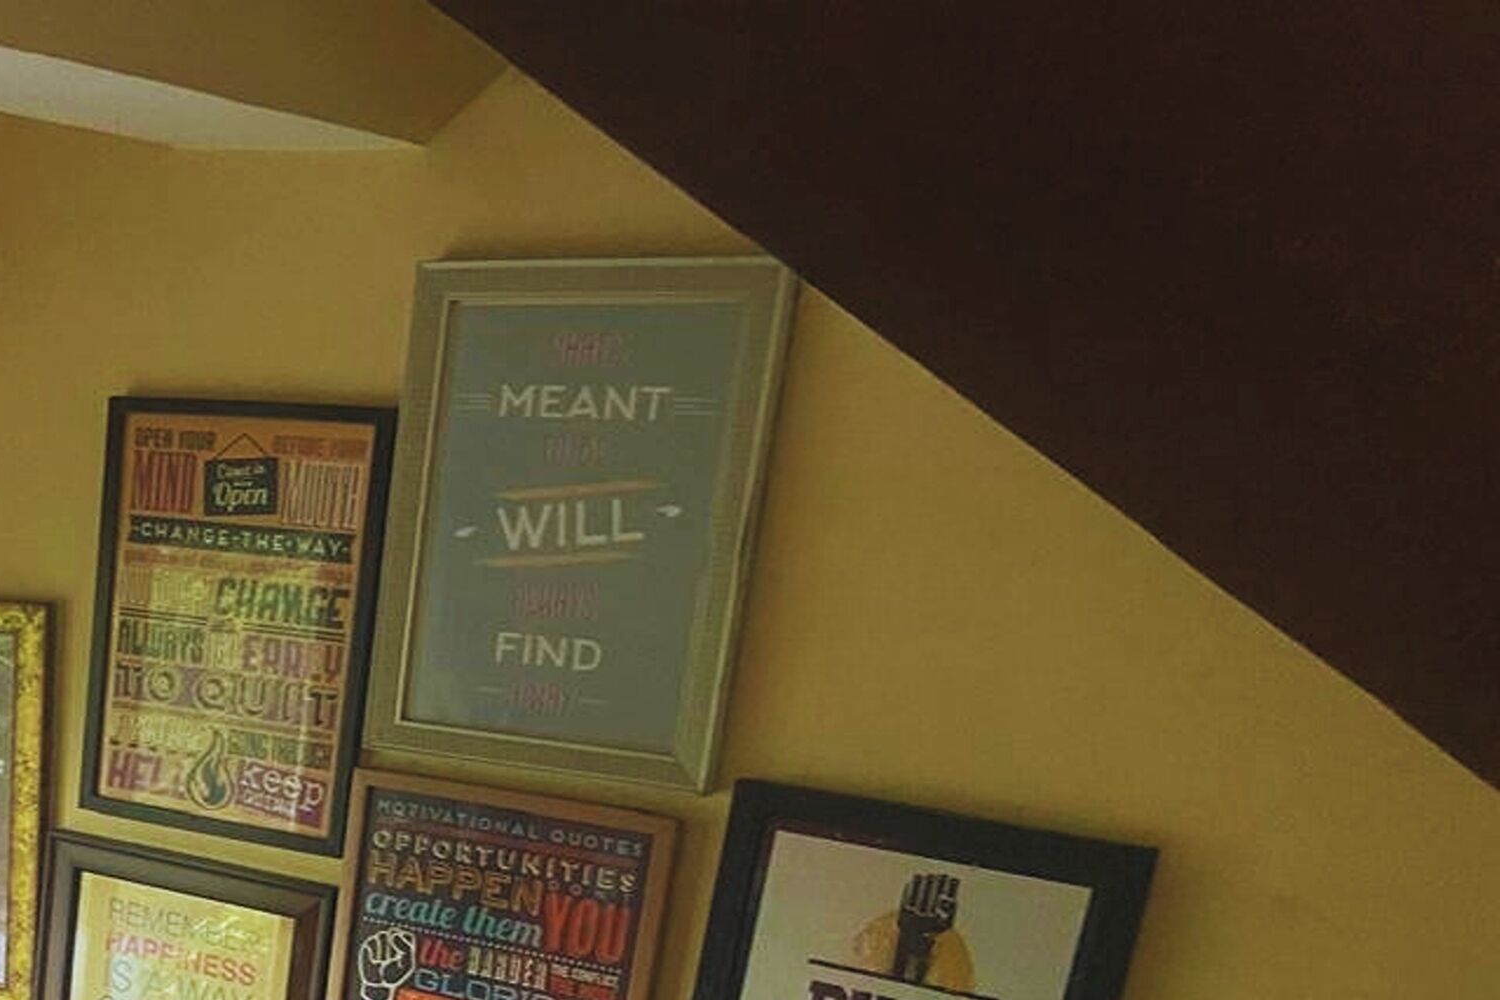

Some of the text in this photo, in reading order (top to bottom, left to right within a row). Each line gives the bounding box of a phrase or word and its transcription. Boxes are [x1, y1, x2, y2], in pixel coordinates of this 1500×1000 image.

[500, 384, 672, 421] MEANT
[212, 482, 268, 513] Open
[497, 499, 645, 550] WILL
[140, 522, 344, 557] CHANGE THE WAY
[213, 576, 350, 630] CHANGE
[495, 633, 602, 671] FIND
[376, 798, 643, 857] MOTIVATIONAL QUOTES
[366, 849, 545, 916] HAPPEN
[372, 829, 637, 894] OPPORTUNITIES
[364, 891, 545, 947] create them
[545, 892, 632, 963] YOU
